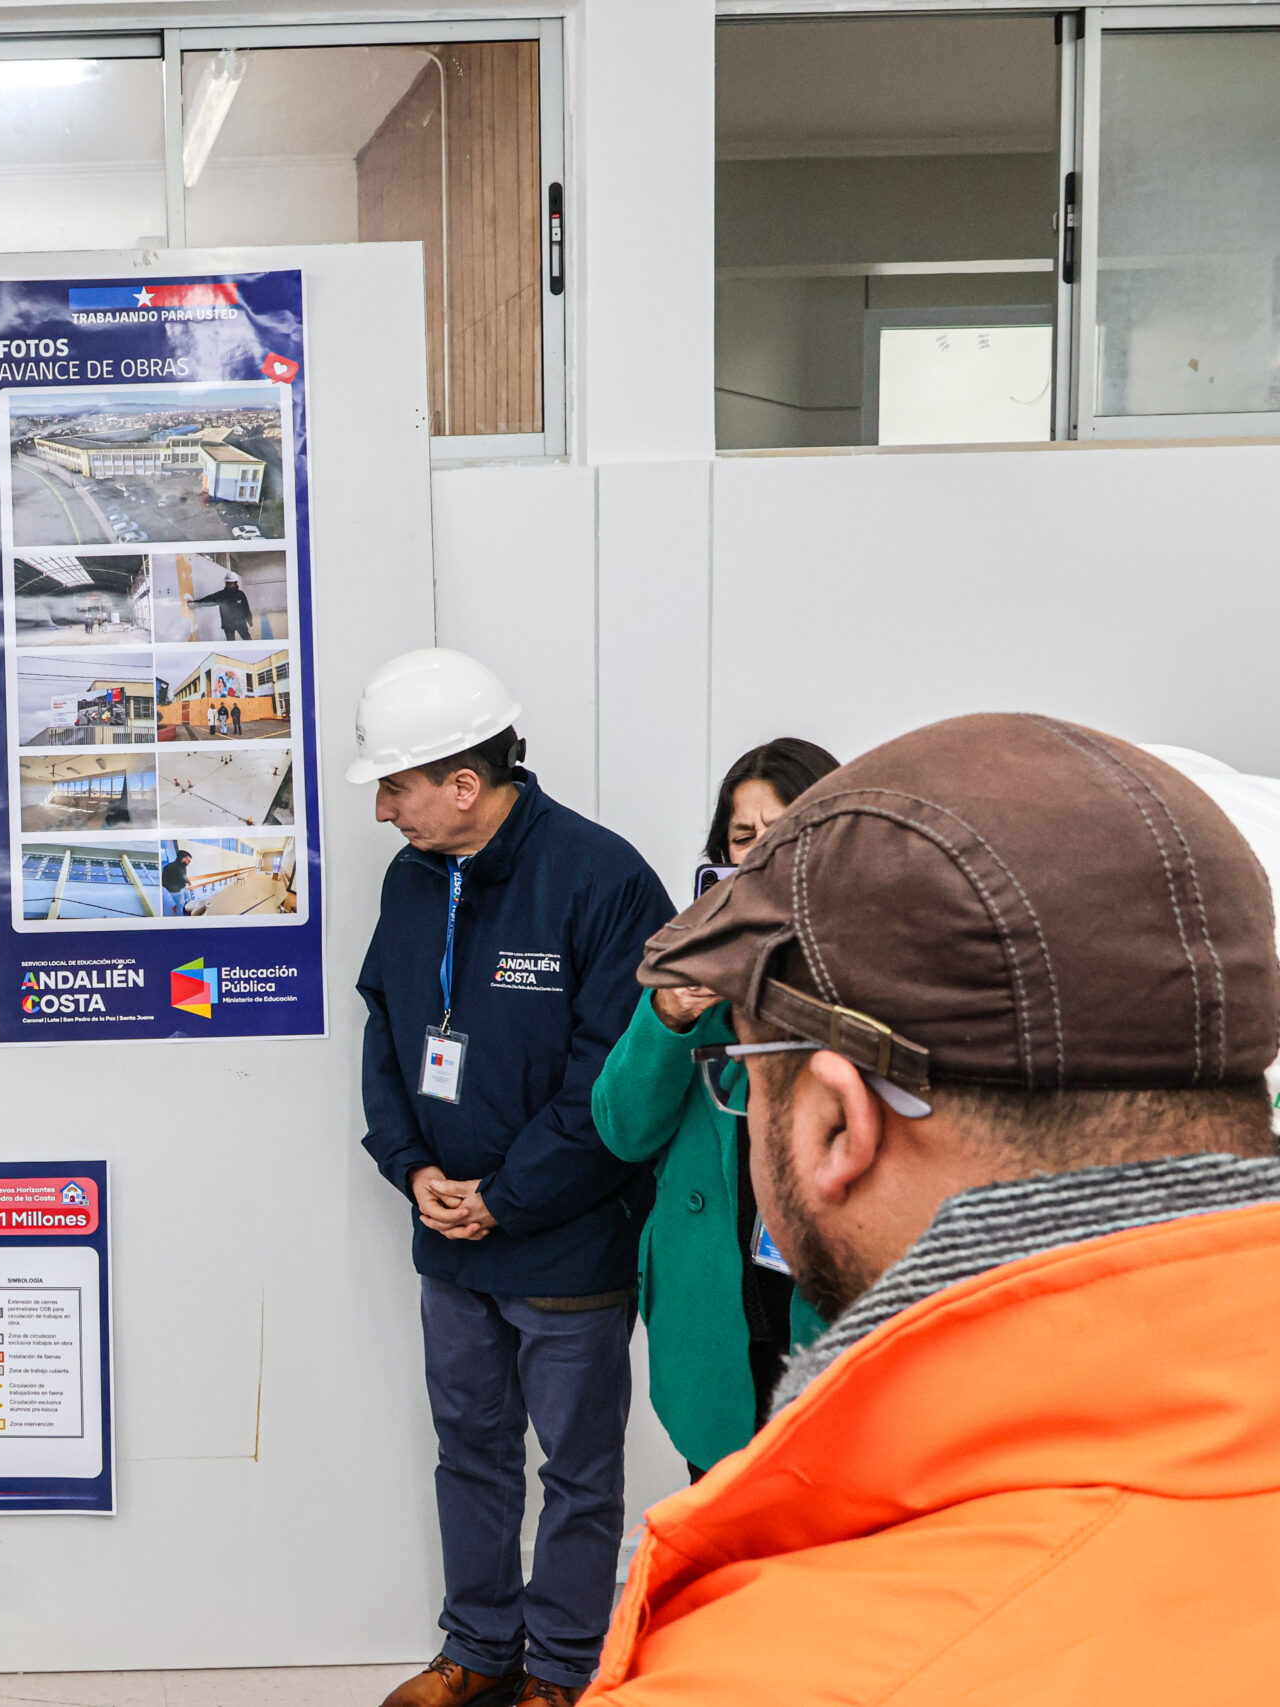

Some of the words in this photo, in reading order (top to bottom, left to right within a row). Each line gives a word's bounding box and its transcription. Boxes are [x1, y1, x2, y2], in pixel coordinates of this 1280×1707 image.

[72, 310, 158, 325] TRABAJANDO
[161, 309, 193, 322] PARA
[196, 308, 238, 321] USTED
[87, 360, 113, 379] DE
[121, 356, 190, 378] OBRAS
[222, 965, 297, 979] Educación
[496, 957, 560, 972] ANDALIÉN
[21, 965, 144, 990] ANDALIÉN
[494, 970, 537, 985] COSTA
[222, 980, 275, 993] Pública
[22, 994, 106, 1013] COSTA
[12, 1211, 87, 1230] Millones
